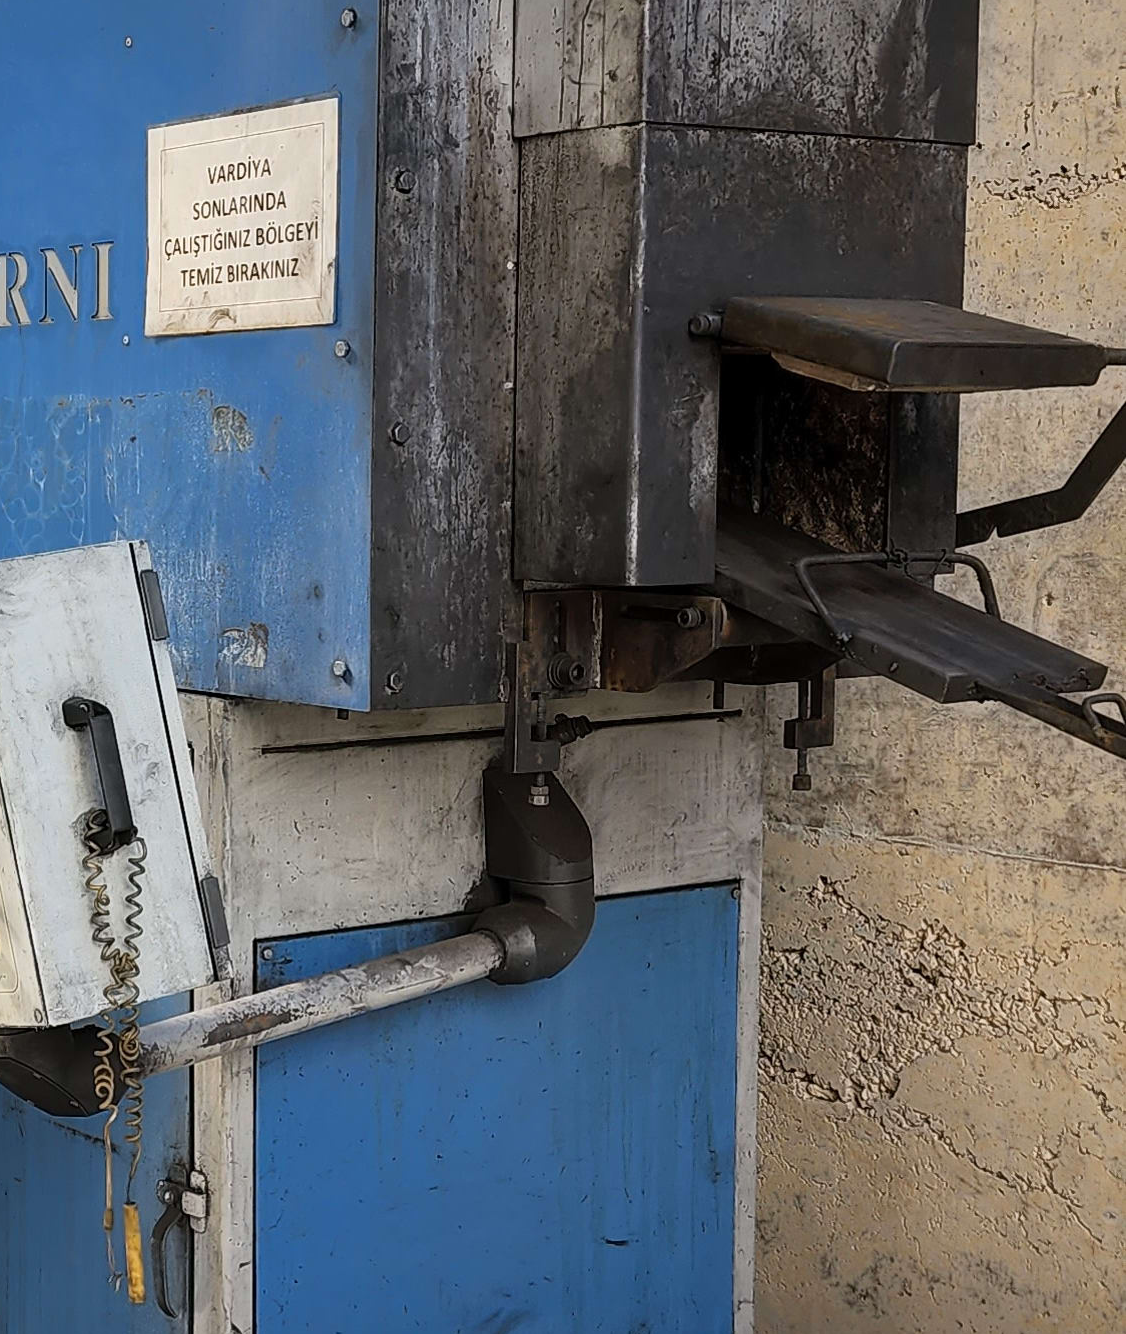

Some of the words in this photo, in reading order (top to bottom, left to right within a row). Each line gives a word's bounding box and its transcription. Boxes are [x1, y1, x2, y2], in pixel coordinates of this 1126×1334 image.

[207, 156, 272, 185] VARDİYA
[192, 190, 287, 221] SONLARINDA
[164, 228, 251, 260] ÇALIŞTIĞINIZ
[255, 216, 319, 246] BÖLGEYİ
[180, 262, 223, 287] TEMİZ
[227, 257, 300, 283] BIRAKINIZ
